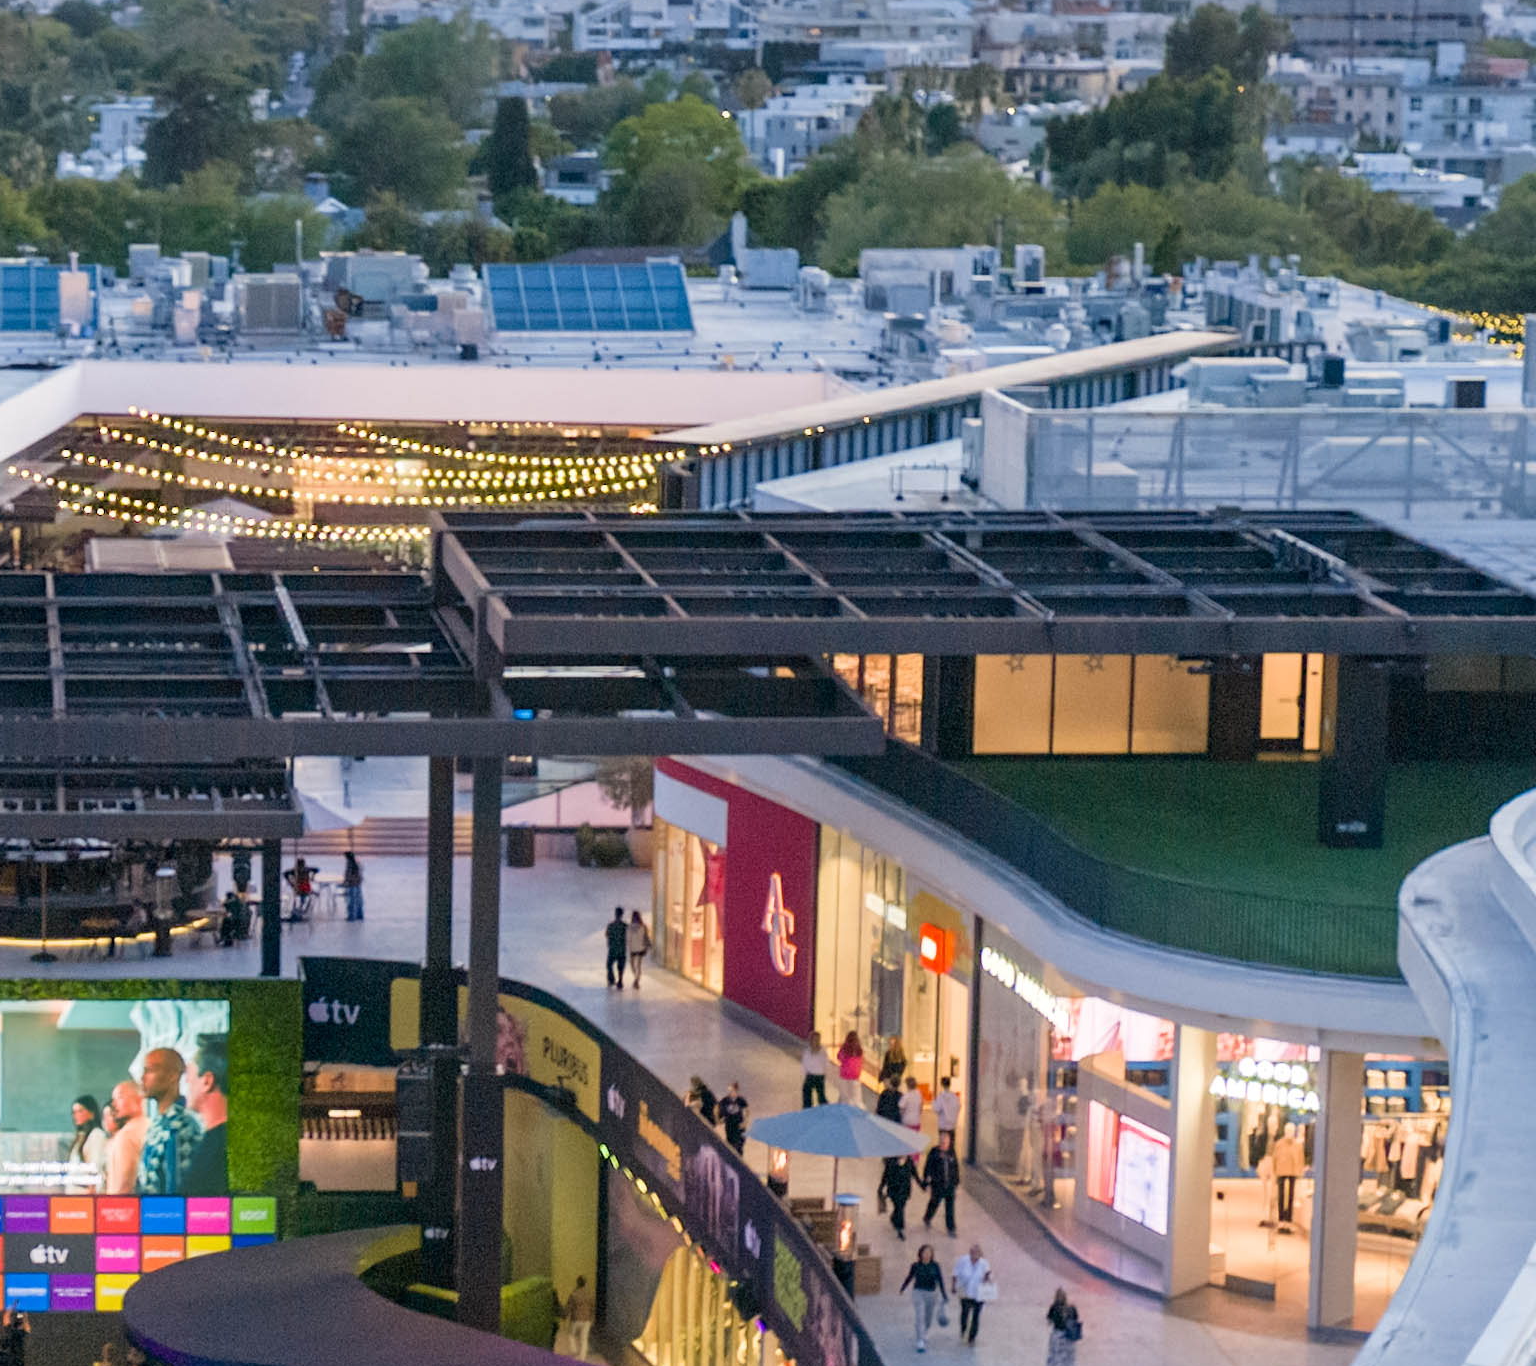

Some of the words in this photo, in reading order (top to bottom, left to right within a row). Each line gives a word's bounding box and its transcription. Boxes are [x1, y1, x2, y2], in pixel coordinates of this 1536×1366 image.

[331, 999, 361, 1025] tv
[1239, 1057, 1308, 1085] GOOD
[1209, 1075, 1320, 1112] AMERICA
[48, 1245, 69, 1264] tv
